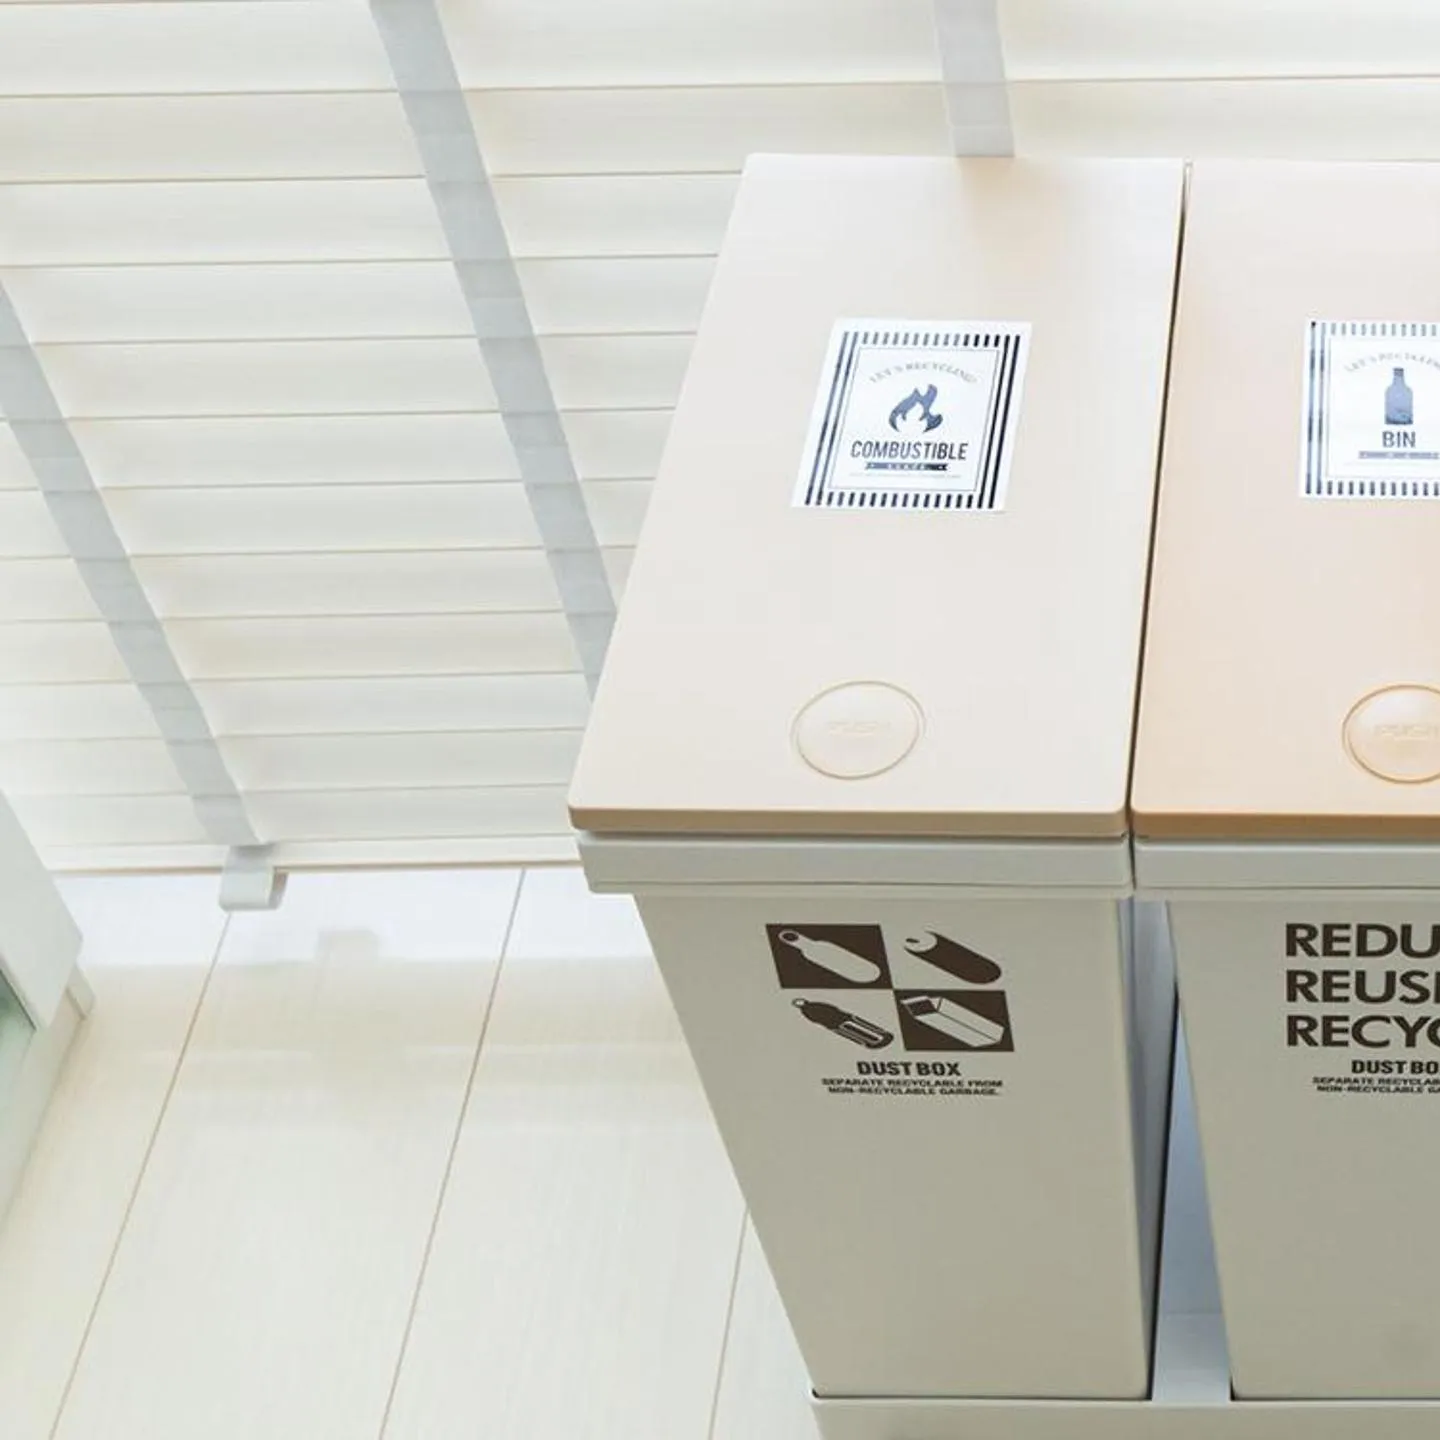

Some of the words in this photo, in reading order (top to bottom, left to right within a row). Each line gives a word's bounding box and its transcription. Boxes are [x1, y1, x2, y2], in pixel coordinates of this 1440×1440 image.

[1382, 431, 1416, 448] BIN
[851, 440, 968, 460] COMBUSTIBLE
[857, 1061, 912, 1075] DUST
[916, 1062, 961, 1076] BOX
[1352, 1060, 1407, 1074] DUST
[821, 1078, 883, 1086] SEPARATE
[886, 1079, 964, 1087] RECYCLABLE
